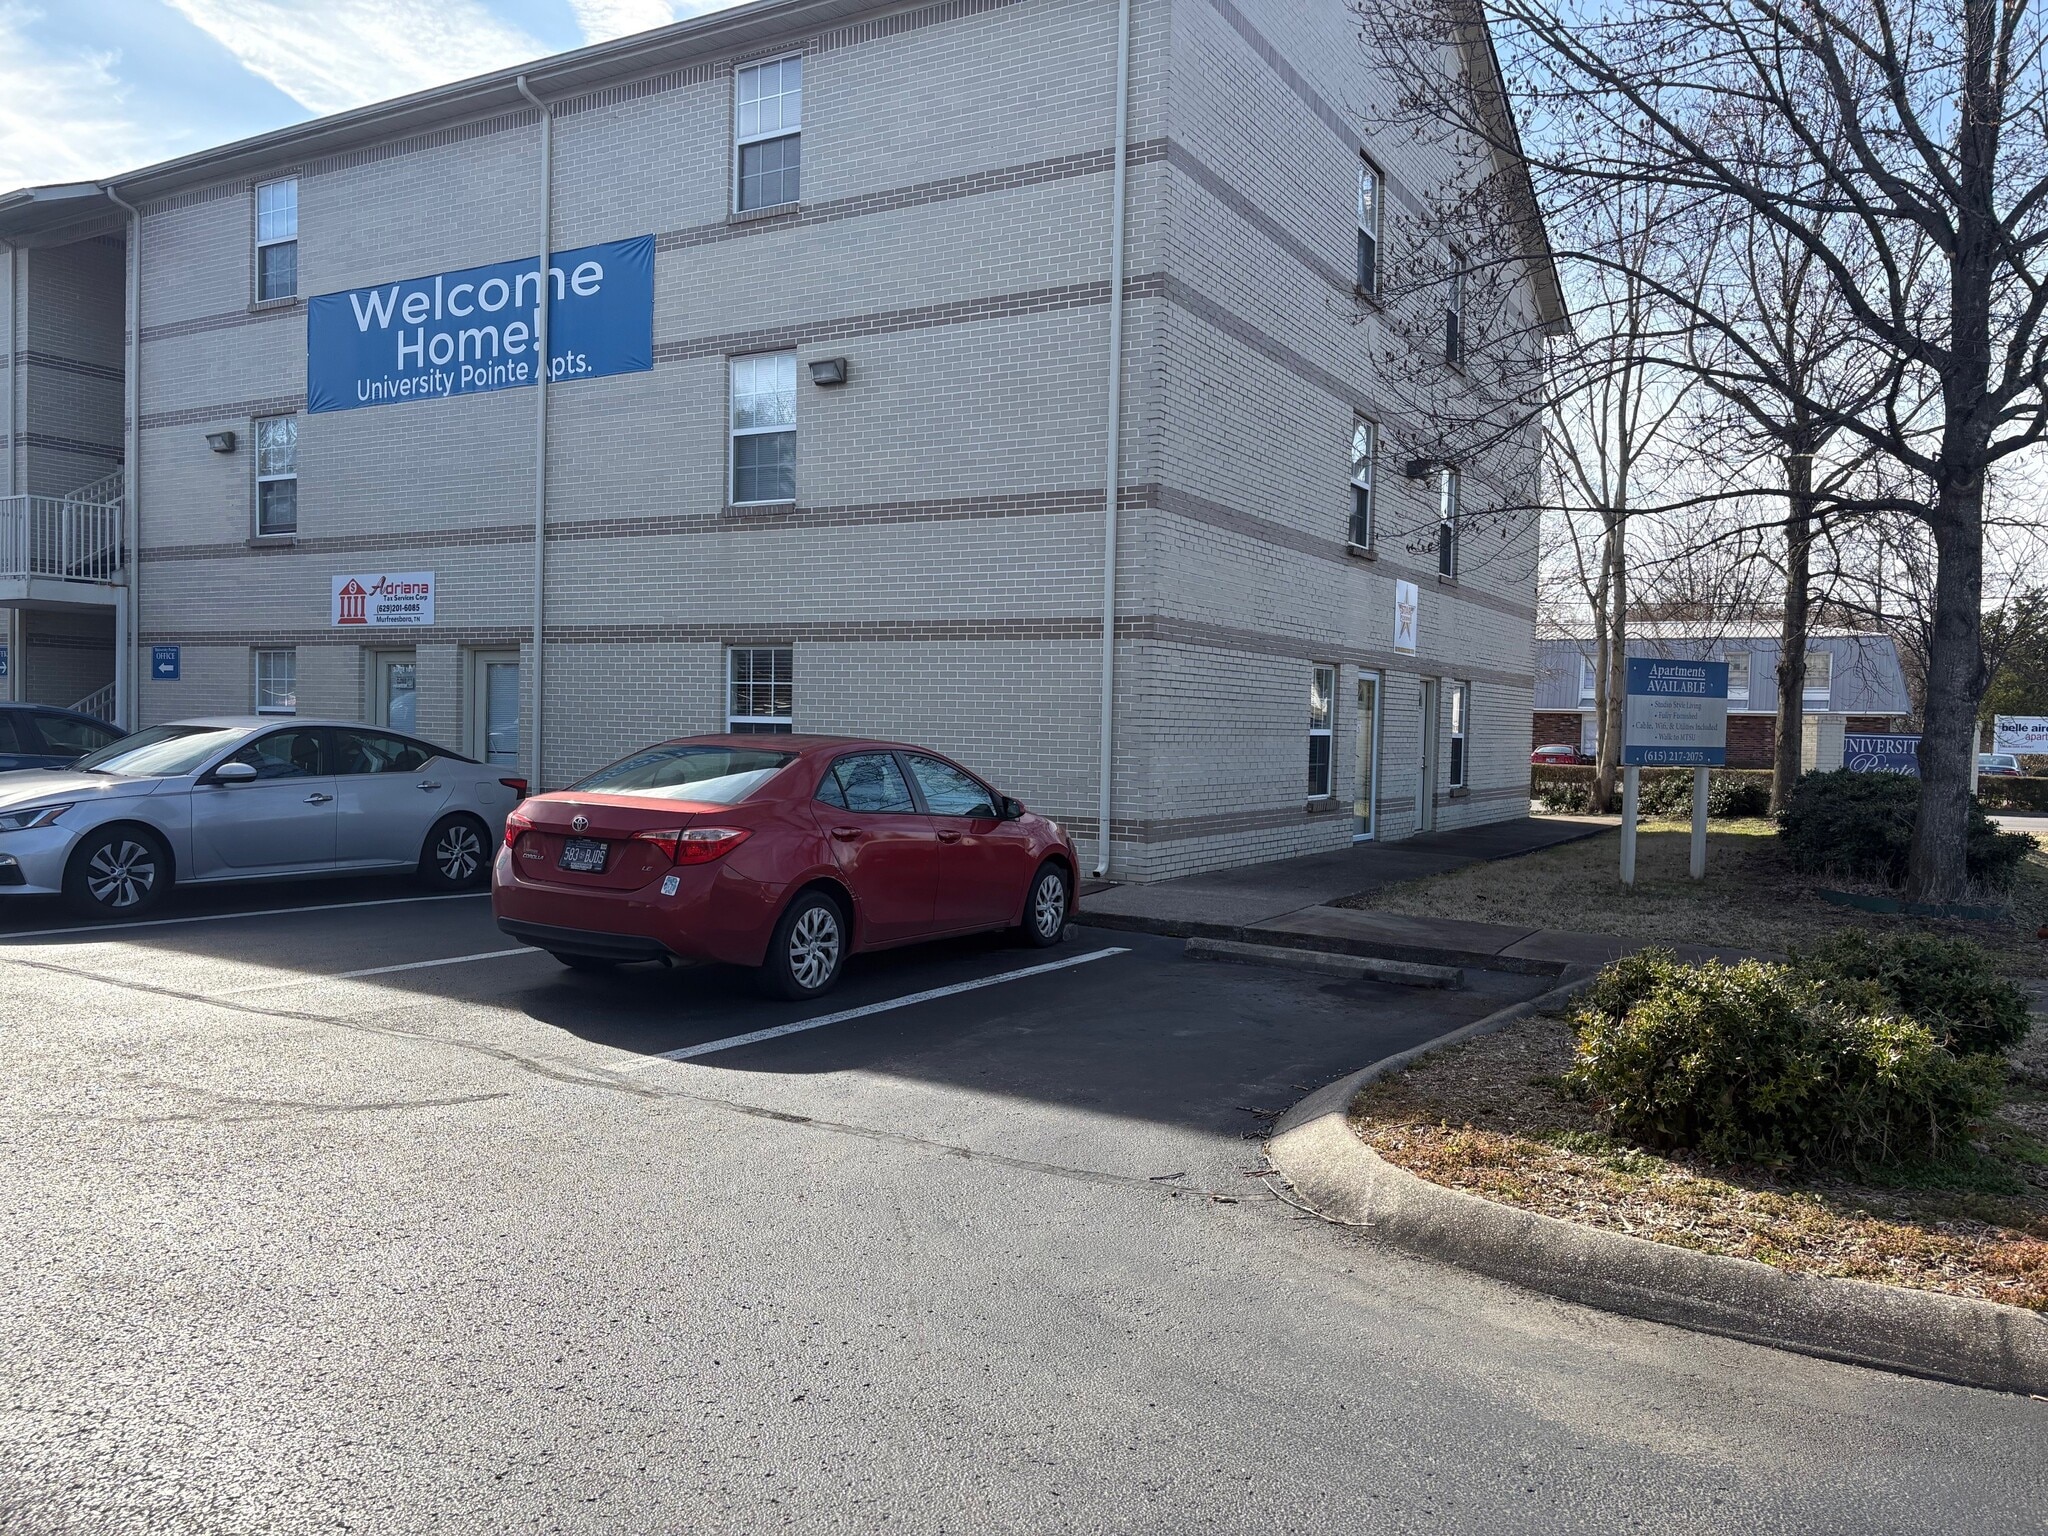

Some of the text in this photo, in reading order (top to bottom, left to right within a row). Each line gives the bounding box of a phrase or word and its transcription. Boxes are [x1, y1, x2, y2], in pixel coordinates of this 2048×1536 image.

[350, 261, 604, 331] Welcome
[397, 308, 540, 370] Home!
[357, 368, 454, 400] University
[461, 359, 529, 388] Pointe
[369, 576, 429, 596] Adriana
[376, 604, 420, 613] (629)201-6085
[156, 652, 176, 660] OFFICE
[1648, 663, 1706, 679] Apartments
[1647, 680, 1706, 694] AVAILABLE
[1673, 701, 1686, 710] Style
[1658, 712, 1672, 720] Fully
[1669, 722, 1675, 730] &
[2001, 723, 2029, 732] belle
[1644, 749, 1704, 762] (615) 217-2075
[564, 847, 580, 861] 583
